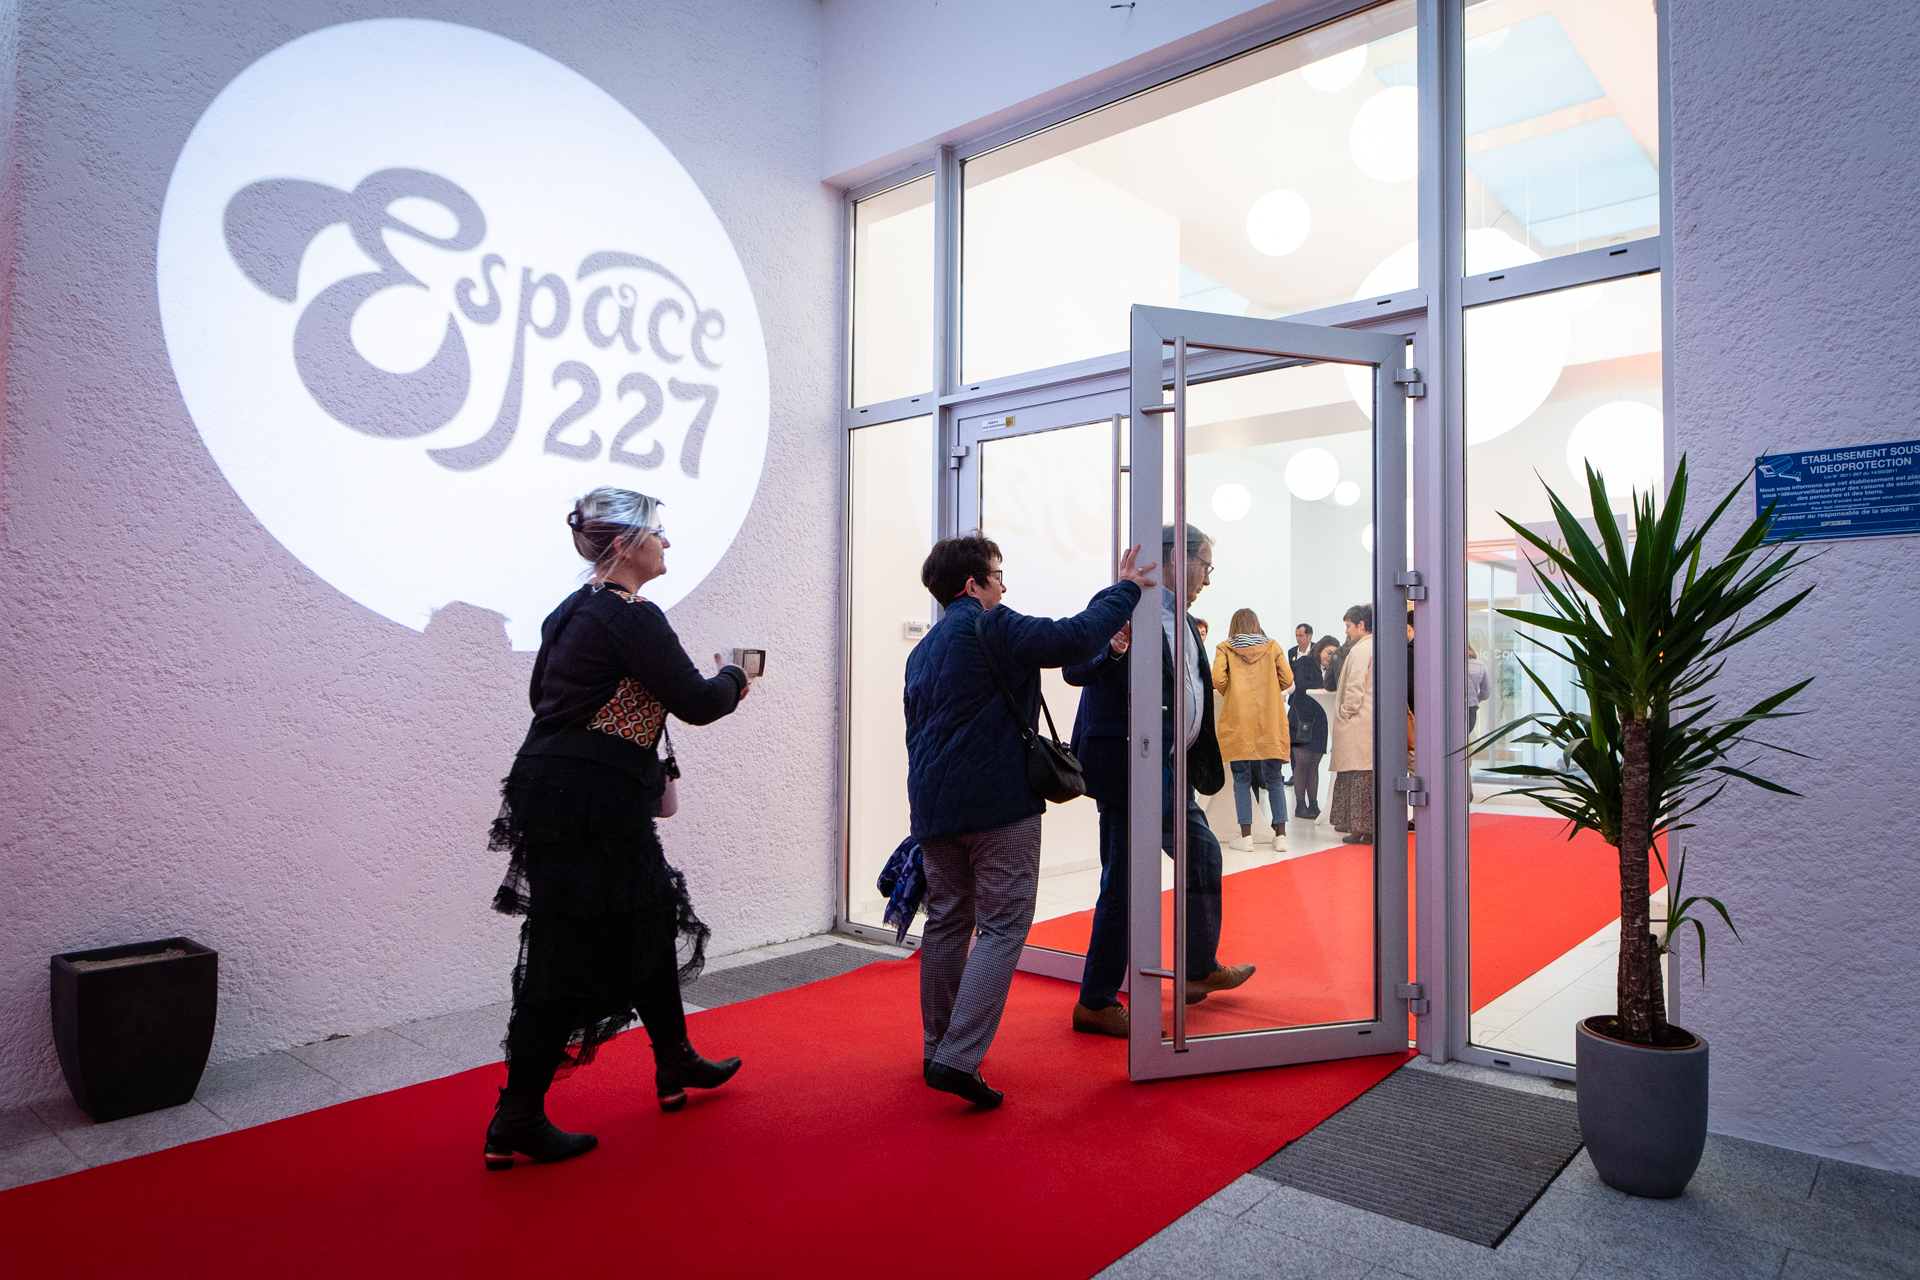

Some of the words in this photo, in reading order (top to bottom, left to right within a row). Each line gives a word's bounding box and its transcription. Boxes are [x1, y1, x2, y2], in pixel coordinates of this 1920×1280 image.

[223, 167, 725, 473] Espace
[542, 360, 720, 479] 227
[1801, 448, 1887, 465] ETABLISSEMENT
[1890, 445, 1920, 456] SOUS
[1810, 457, 1912, 474] VIDEOPROTECTION
[1848, 475, 1894, 485] établissement
[1809, 492, 1842, 501] personnes
[1817, 510, 1859, 518] responsable
